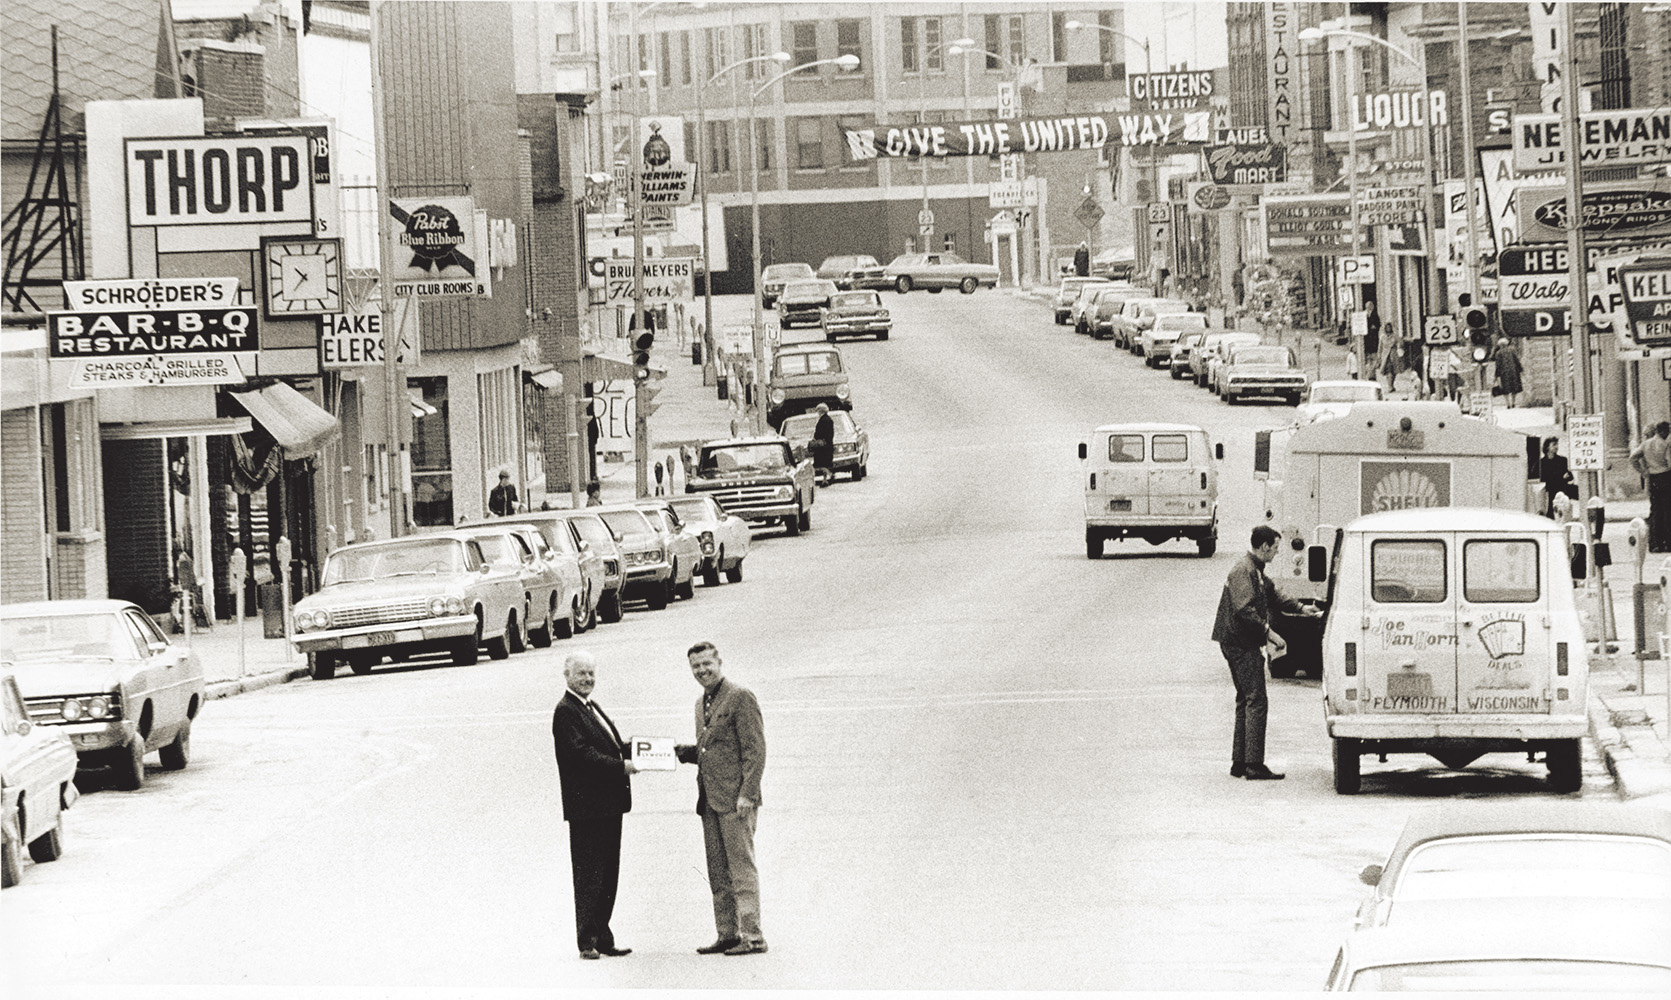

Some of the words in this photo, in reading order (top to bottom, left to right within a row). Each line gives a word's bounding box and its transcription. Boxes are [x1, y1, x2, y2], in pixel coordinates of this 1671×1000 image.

[1353, 89, 1448, 131] LIQUOR
[886, 127, 948, 157] GIVE
[960, 121, 1010, 155] THE
[1020, 116, 1108, 152] UNITED
[1118, 112, 1172, 147] WAY
[1524, 115, 1671, 149] NEEMAN
[135, 146, 300, 216] THORP
[1234, 167, 1278, 183] MART
[640, 181, 687, 192] ILLIAMS
[412, 212, 450, 230] Pabst
[1152, 208, 1167, 219] 23
[1367, 211, 1408, 225] STORE
[400, 232, 425, 246] Blue
[426, 232, 465, 246] Ribbon
[610, 263, 689, 279] BRUMEYERS
[81, 281, 224, 305] SCHROEDER'S
[395, 284, 414, 297] CITY
[417, 283, 440, 296] CLUB
[443, 282, 473, 295] ROOMS
[57, 310, 250, 337] BAR-B-Q
[1430, 325, 1452, 340] 23
[58, 333, 247, 353] RESTAURANT
[85, 361, 160, 373] CHARCOAL
[166, 359, 224, 370] GRILLED
[83, 371, 134, 382] STEAKS
[139, 371, 147, 380] &
[152, 368, 229, 380] HAMBURGERS
[1582, 449, 1593, 457] TO
[1371, 616, 1406, 637] Joe
[1487, 659, 1523, 671] DEALS
[1373, 695, 1447, 710] PLYMOUTH
[1467, 696, 1540, 710] WISCONSIN
